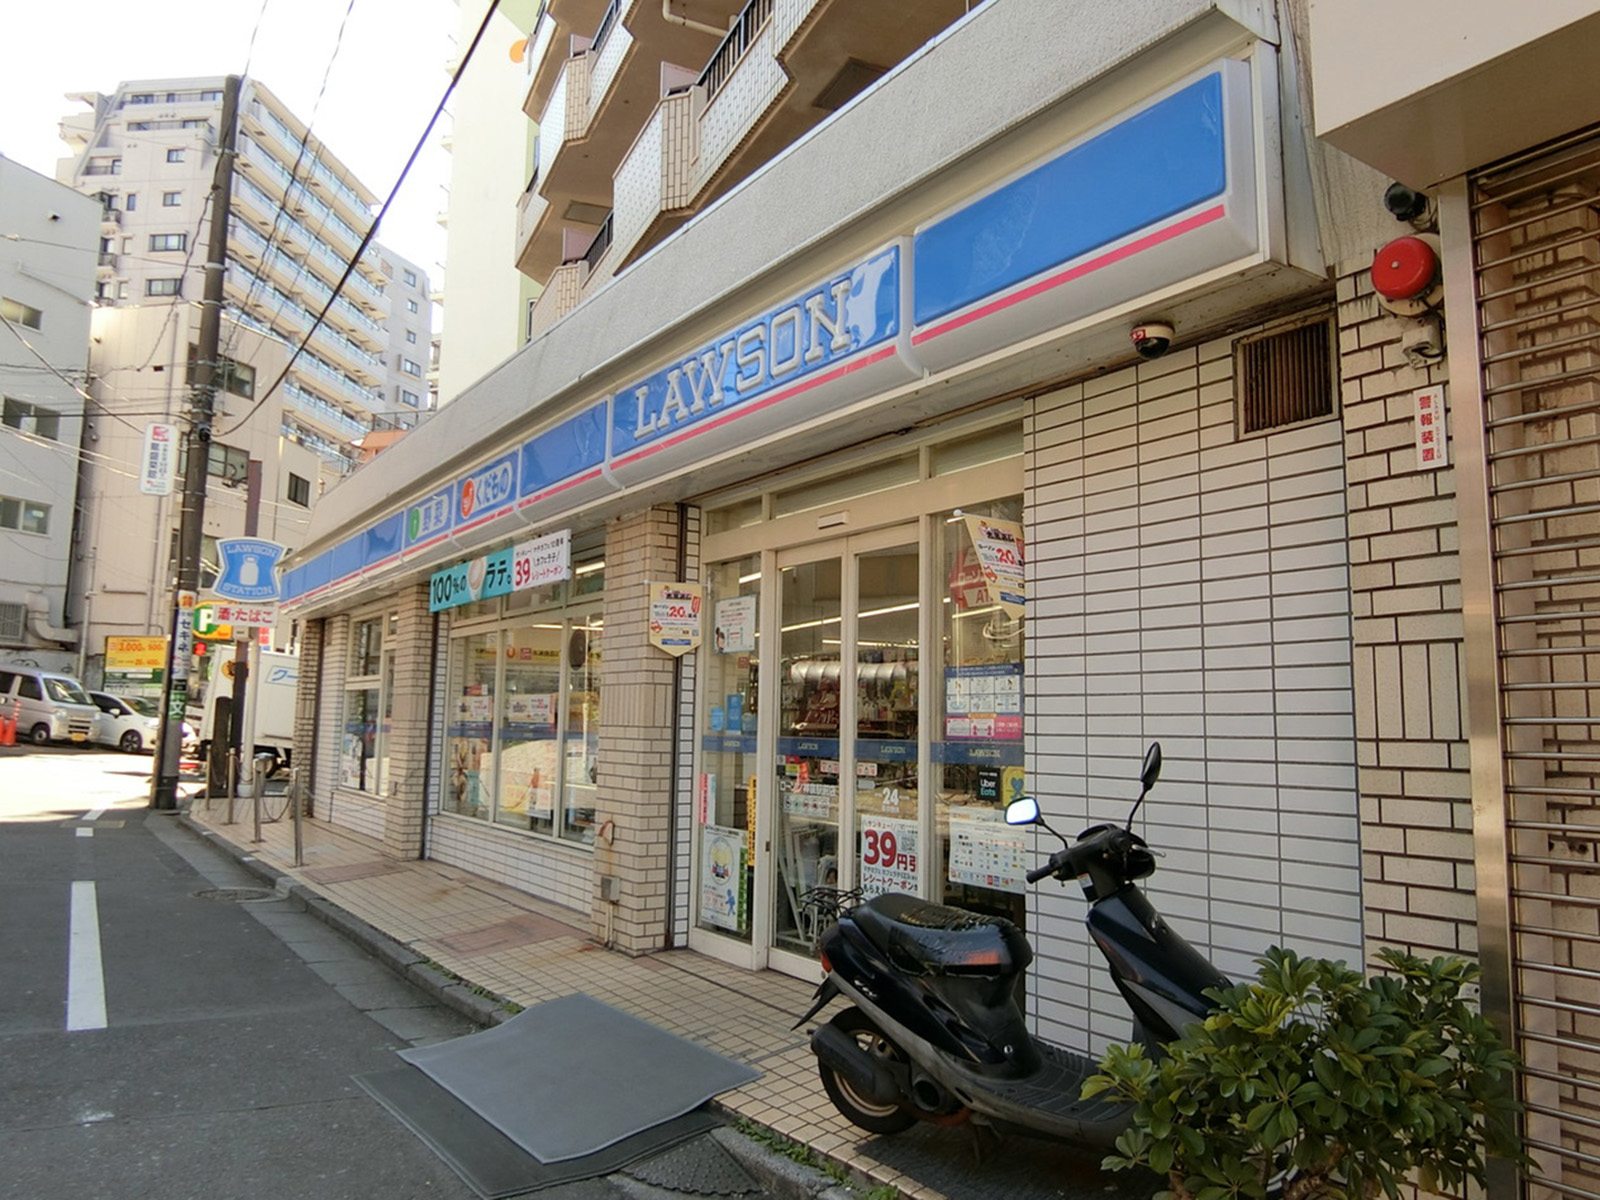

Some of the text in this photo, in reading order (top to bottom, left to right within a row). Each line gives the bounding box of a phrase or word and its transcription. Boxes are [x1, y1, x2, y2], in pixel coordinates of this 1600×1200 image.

[634, 277, 850, 439] LAWSON
[1419, 395, 1435, 462] 警報装置
[476, 467, 509, 507] くだもの
[226, 544, 278, 557] LAWSON
[222, 583, 274, 596] STATION
[432, 573, 467, 606] 100%の
[198, 609, 213, 632] P
[218, 607, 273, 623] 酒・たばこ
[178, 619, 191, 652] セキネ
[980, 779, 996, 788] Uber
[980, 788, 996, 797] Eats
[883, 787, 899, 805] 24
